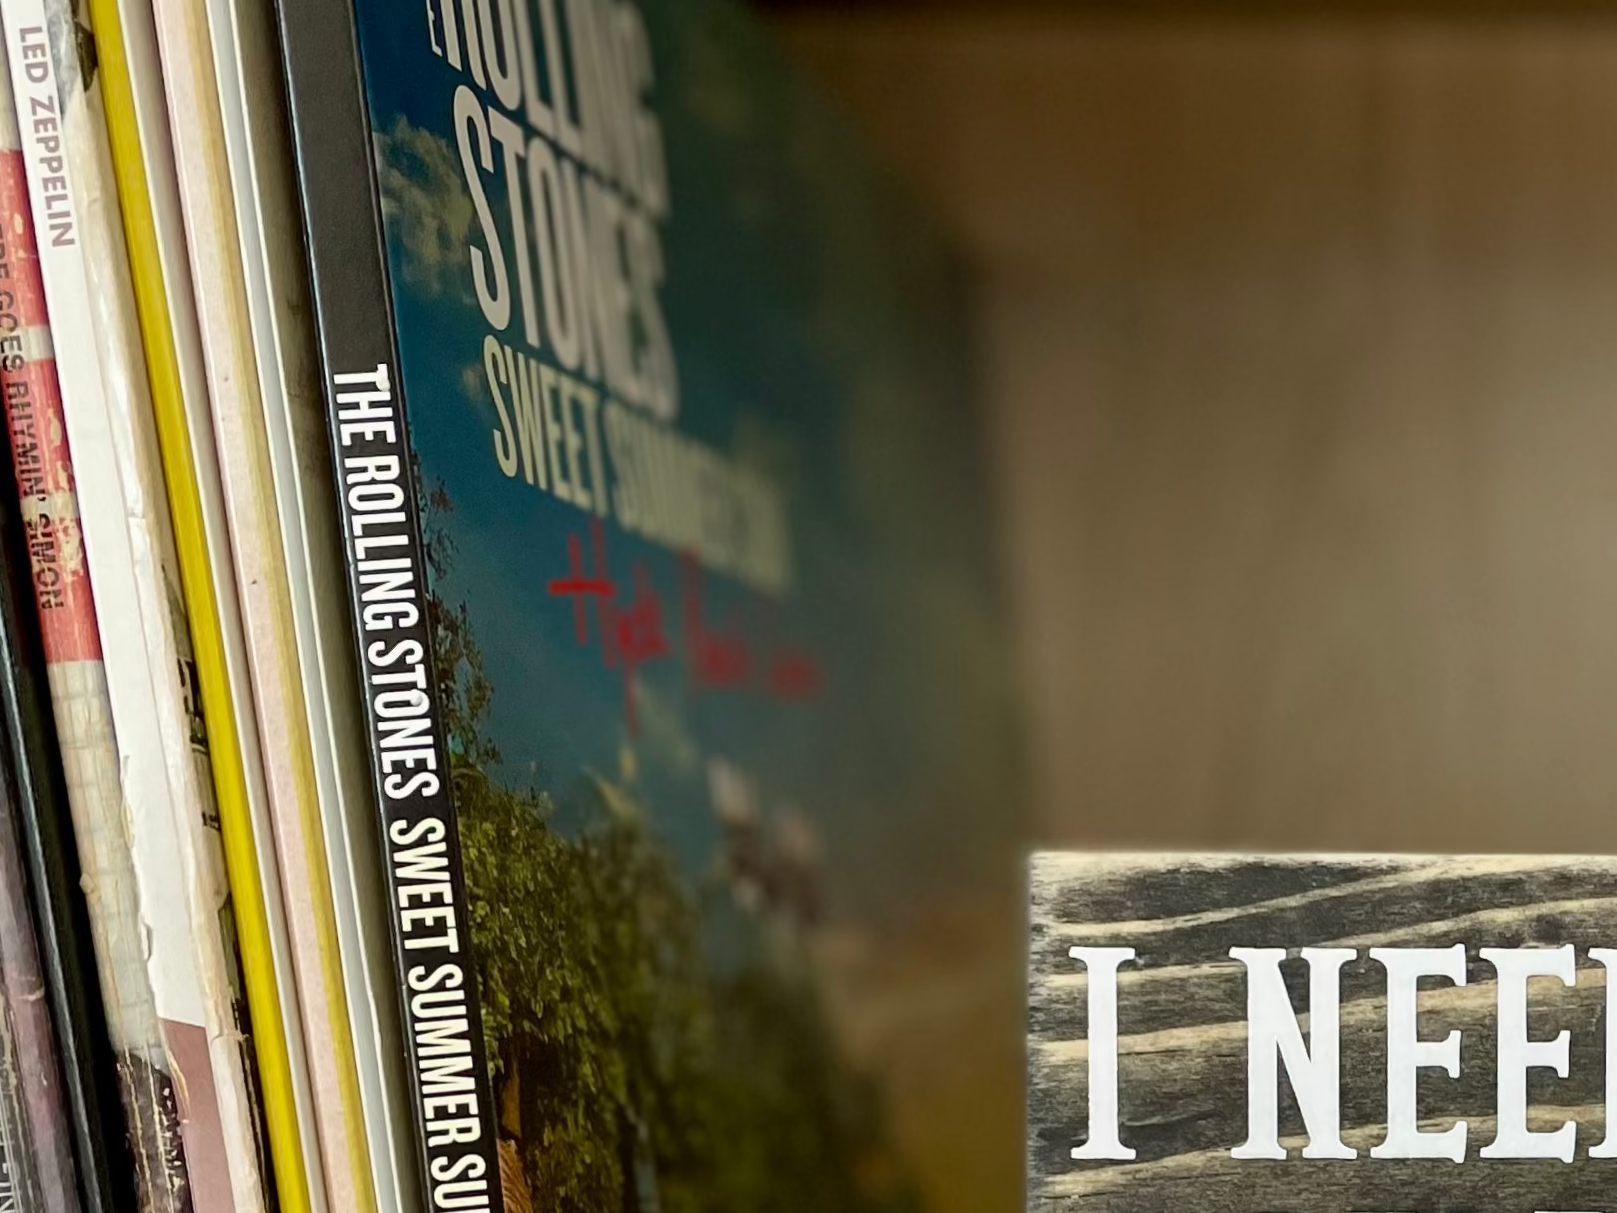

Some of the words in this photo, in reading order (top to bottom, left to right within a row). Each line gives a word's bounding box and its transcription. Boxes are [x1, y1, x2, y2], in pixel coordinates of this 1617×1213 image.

[20, 26, 49, 84] LED
[30, 96, 75, 248] ZEPPELIN
[333, 364, 397, 447] THE
[483, 334, 609, 520] SWEET
[344, 455, 419, 632] ROLLING
[367, 639, 441, 801] STONES
[389, 817, 460, 954] SWEET
[408, 963, 482, 1148] SUMMER
[1068, 946, 1138, 1162] I
